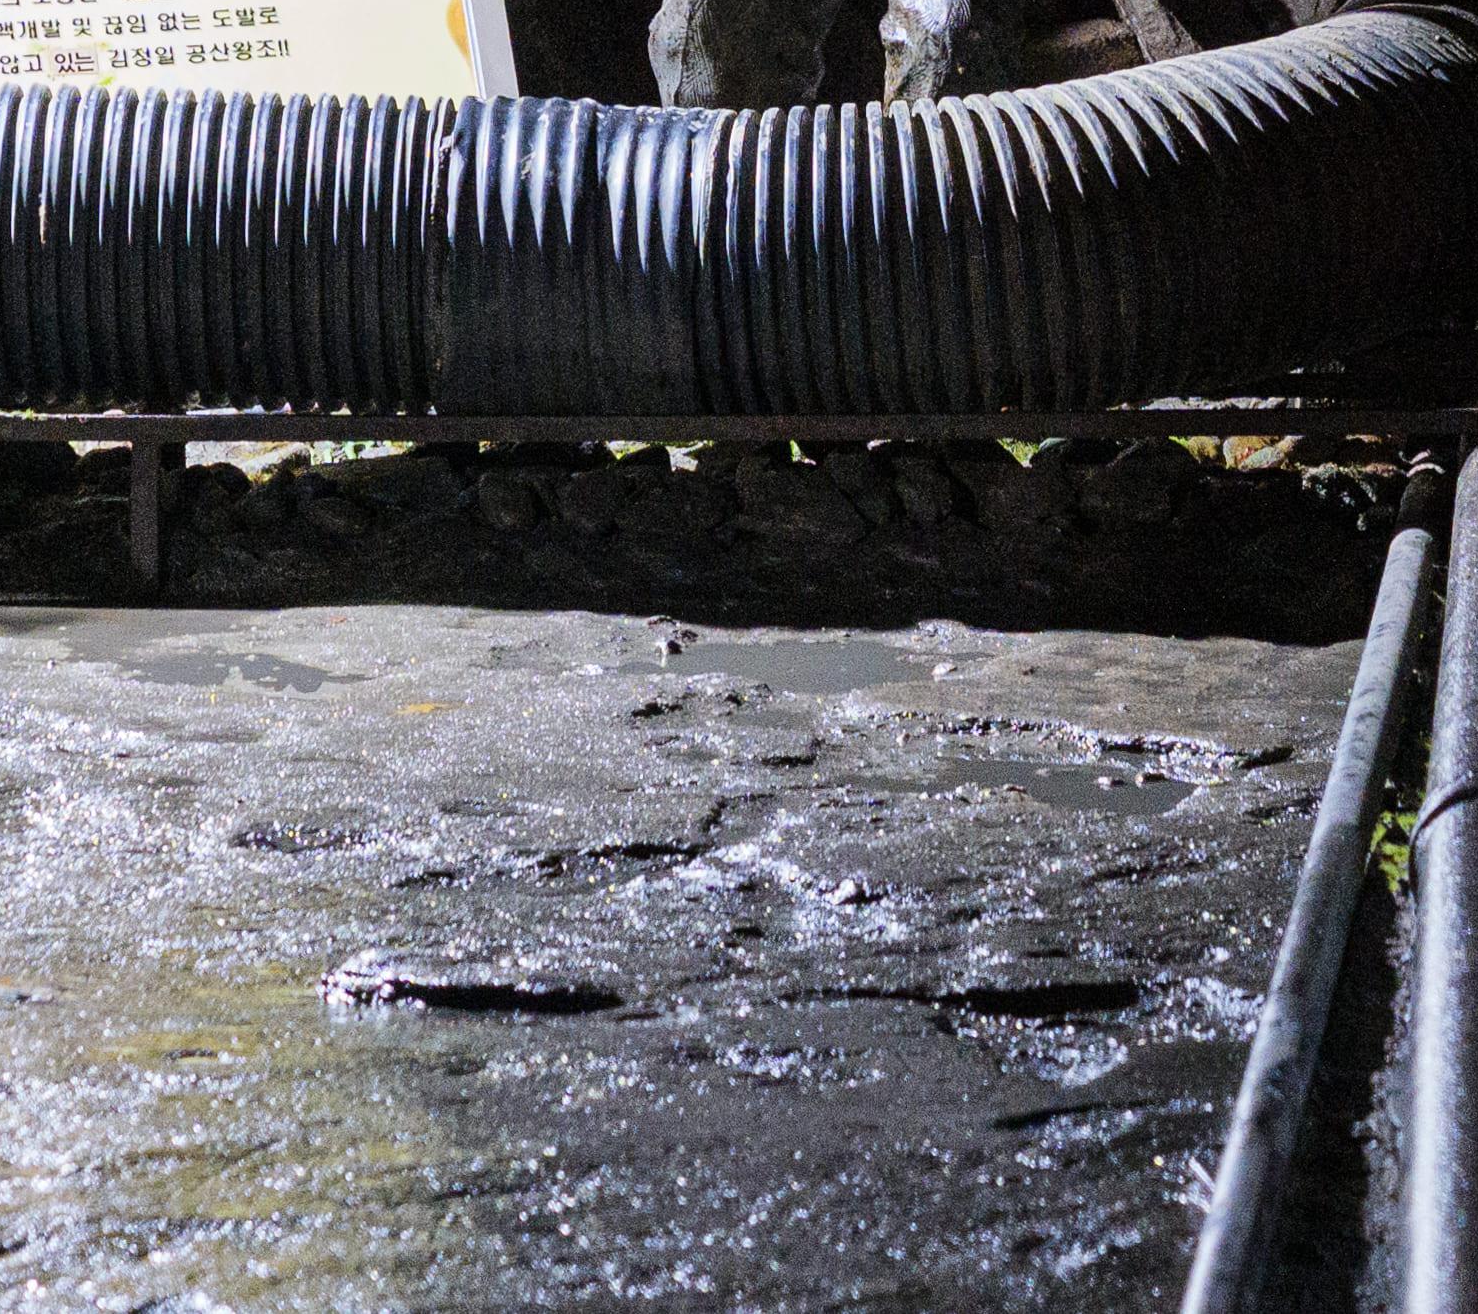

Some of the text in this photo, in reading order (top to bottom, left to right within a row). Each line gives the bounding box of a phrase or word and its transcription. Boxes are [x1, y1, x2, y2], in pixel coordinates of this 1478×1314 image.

[72, 17, 93, 38] 및
[103, 13, 148, 36] 끊임
[157, 11, 201, 32] 없는
[212, 5, 281, 29] 도발로
[53, 51, 96, 74] 있는
[107, 44, 177, 70] 김정일
[185, 38, 291, 64] 공산왕조!!
